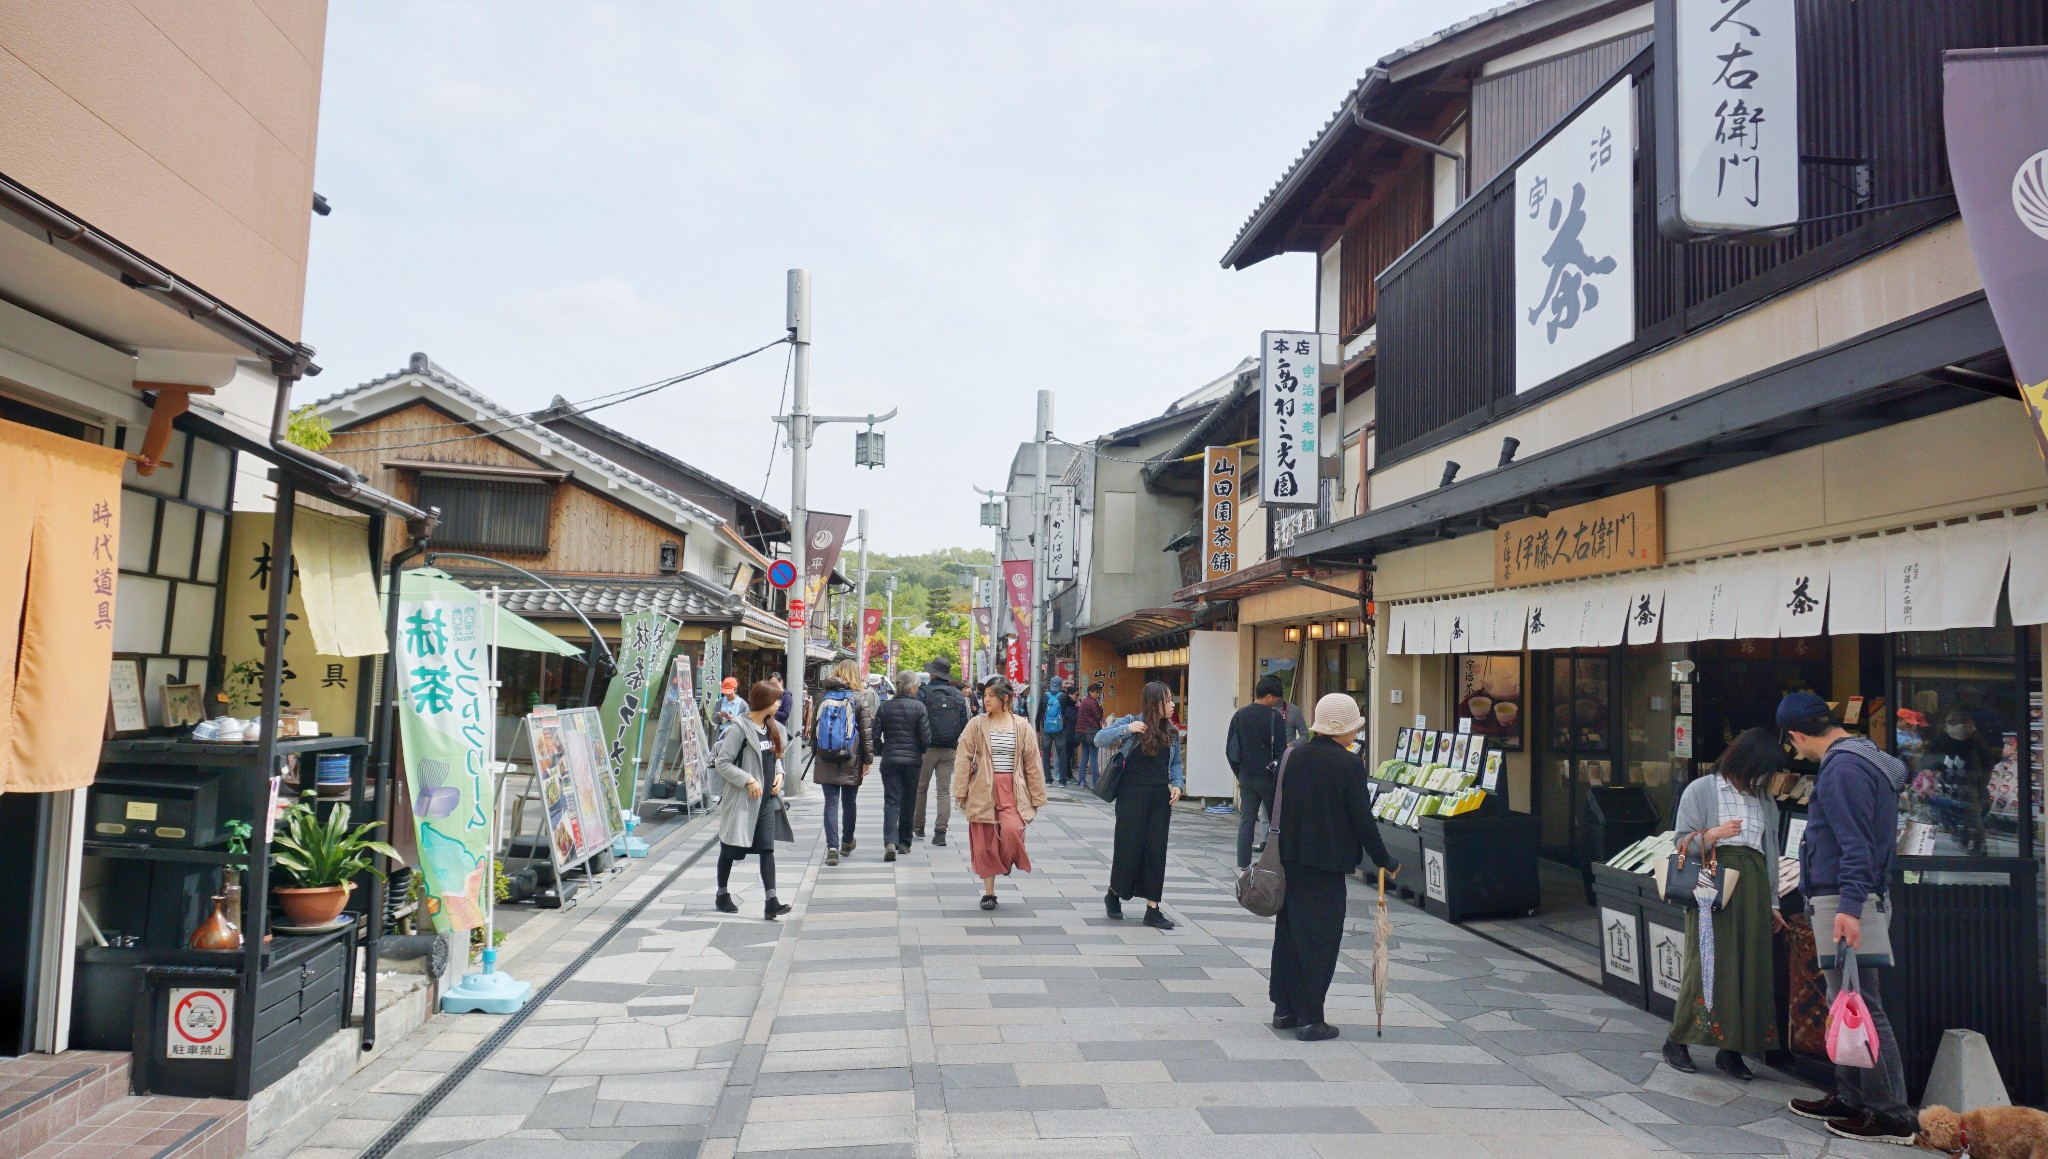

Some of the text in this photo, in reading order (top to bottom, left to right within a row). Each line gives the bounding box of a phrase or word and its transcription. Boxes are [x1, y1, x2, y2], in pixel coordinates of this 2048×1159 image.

[1528, 182, 1617, 345] 茶
[1273, 338, 1310, 355] 本店
[1301, 364, 1315, 453] 宇治茶老舗
[1210, 455, 1235, 572] 山田園茶舗
[1052, 519, 1064, 575] かんばやし
[1503, 529, 1512, 580] 宇治茶
[1516, 512, 1635, 571] 伊藤久右衛門
[92, 503, 114, 630] 時代道具
[1634, 594, 1656, 627] 茶
[1786, 576, 1819, 616] 茶
[1904, 565, 1912, 625] 伊藤久右衛門
[1453, 616, 1464, 640] 茶
[1529, 606, 1545, 634] 茶
[1465, 660, 1477, 696] 宇治茶
[1666, 944, 1674, 977] 宇治茶
[172, 1044, 226, 1057] 駐車禁止
